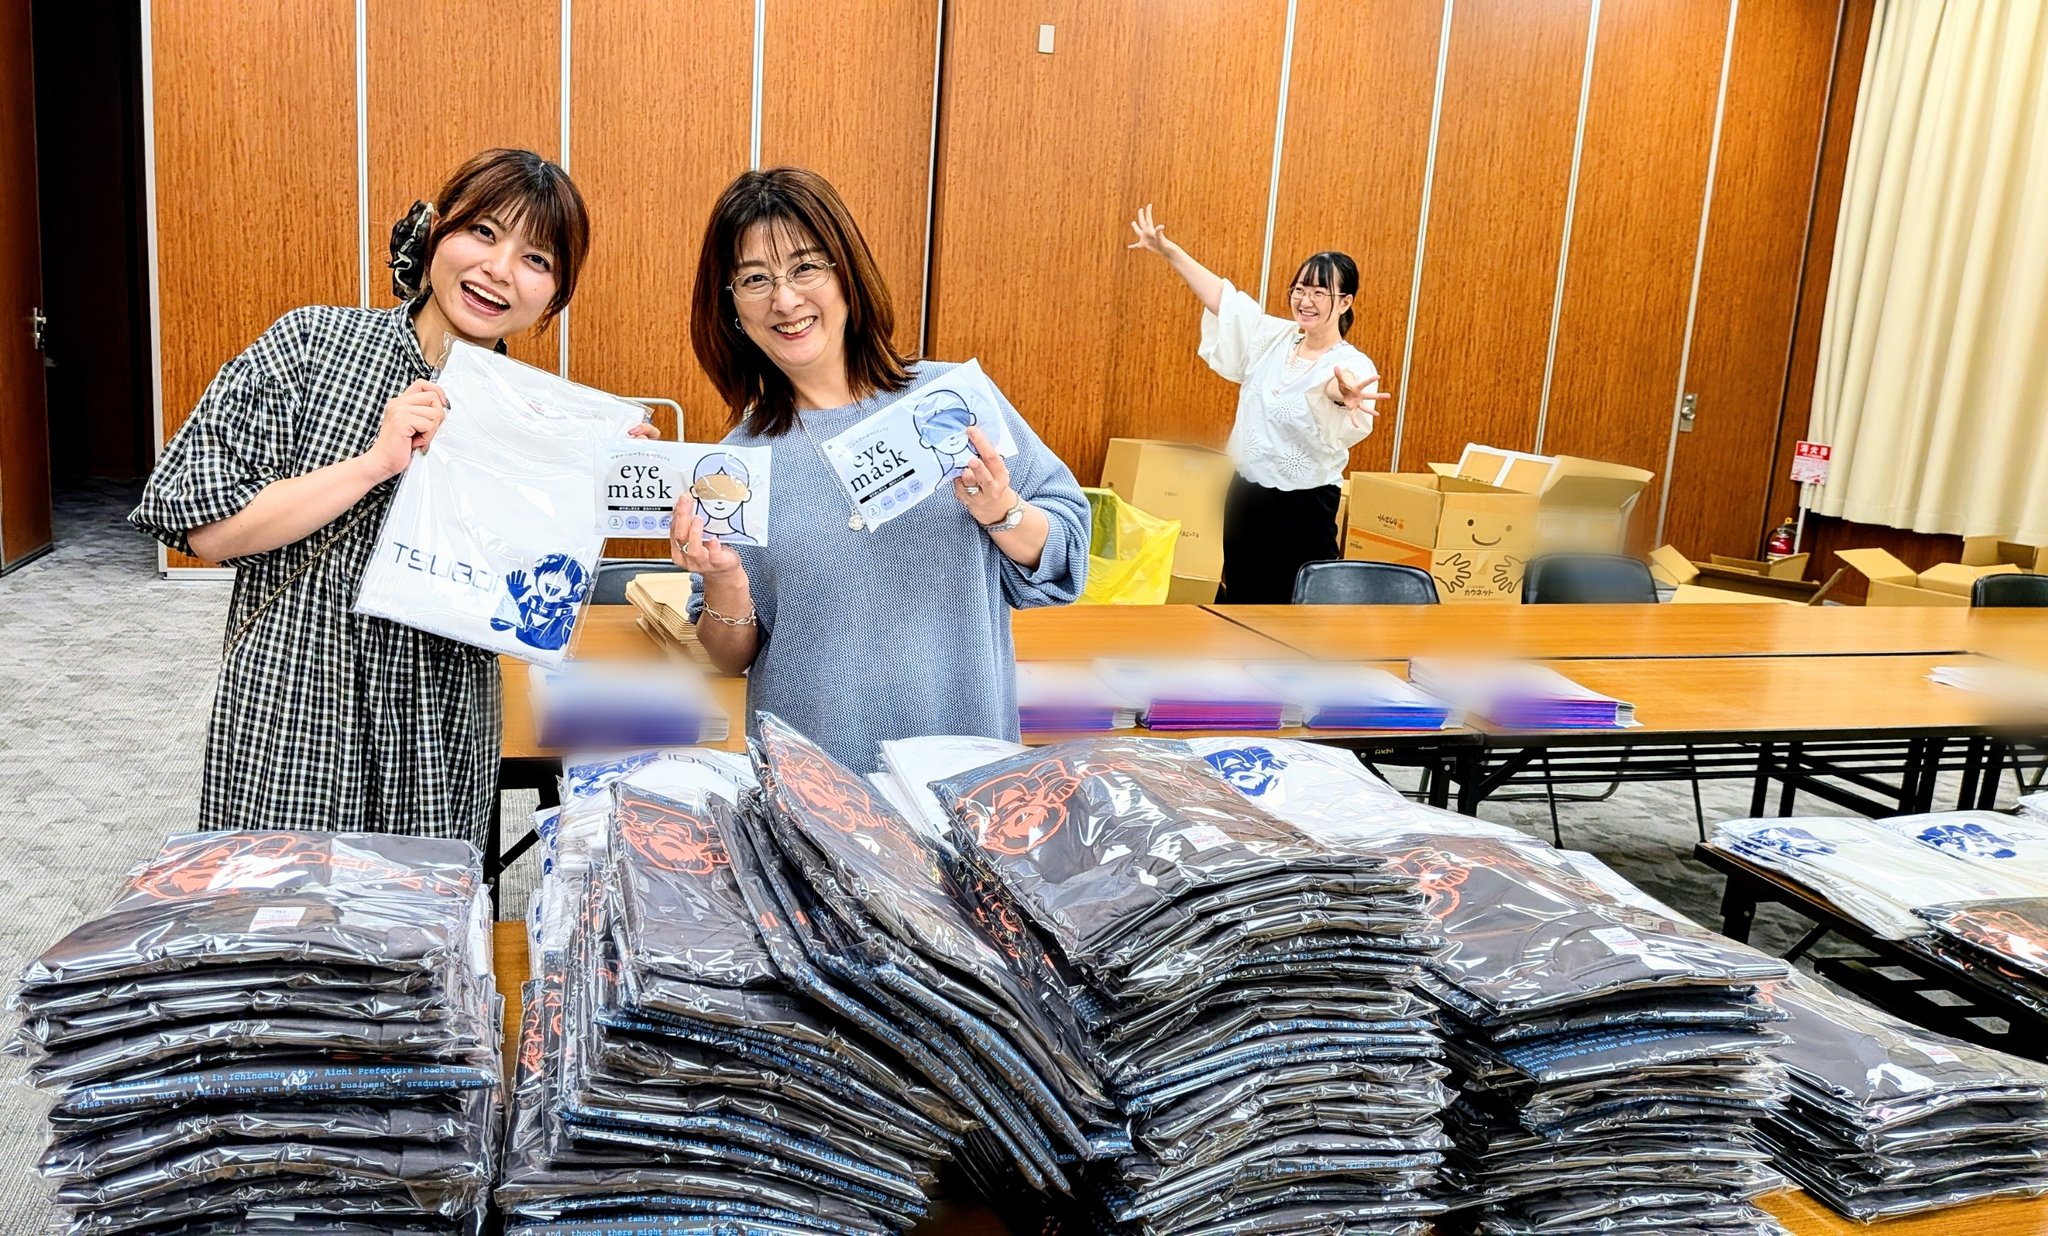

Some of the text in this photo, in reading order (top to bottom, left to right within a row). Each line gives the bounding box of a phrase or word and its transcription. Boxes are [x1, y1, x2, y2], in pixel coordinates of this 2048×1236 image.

[854, 440, 888, 468] eye
[620, 465, 660, 483] eye
[850, 449, 909, 493] mask
[607, 479, 673, 499] mask
[393, 540, 500, 595] TSUBOI
[1464, 589, 1494, 597] カウネット
[637, 1023, 655, 1031] and,
[661, 1024, 691, 1036] though
[1595, 1043, 1618, 1053] guitar
[990, 1050, 1017, 1076] choosing
[212, 1073, 223, 1082] in
[229, 1071, 286, 1081] Ichinomiya
[325, 1067, 353, 1076] Aichi
[358, 1067, 413, 1075] Prefecture
[420, 1067, 446, 1075] (back
[153, 1092, 177, 1100] into
[193, 1087, 229, 1097] family
[234, 1086, 256, 1094] that
[297, 1081, 336, 1091] textile
[340, 1079, 389, 1089] business.
[406, 1079, 456, 1090] graduated
[931, 1036, 944, 1048] and
[943, 1048, 971, 1076] choosing
[977, 1082, 991, 1098] life
[990, 1098, 1000, 1107] of
[1020, 1133, 1044, 1162] non-stop
[996, 1130, 1021, 1158] non-stop
[785, 1139, 803, 1150] life
[807, 1146, 817, 1154] of
[821, 1149, 852, 1167] talking
[856, 1162, 892, 1181] non-stop
[678, 1138, 707, 1149] guitar
[712, 1144, 727, 1152] and
[731, 1147, 769, 1162] choosing
[818, 1172, 848, 1188] talking
[852, 1183, 888, 1201] non-stop
[891, 1196, 900, 1205] in
[617, 1194, 647, 1205] guitar
[651, 1195, 667, 1203] and
[671, 1196, 711, 1208] choosing
[727, 1201, 746, 1210] life
[750, 1203, 761, 1212] of
[627, 1215, 659, 1224] family
[664, 1214, 684, 1222] that
[607, 1228, 633, 1236] there
[637, 1228, 663, 1236] might
[667, 1228, 689, 1236] have
